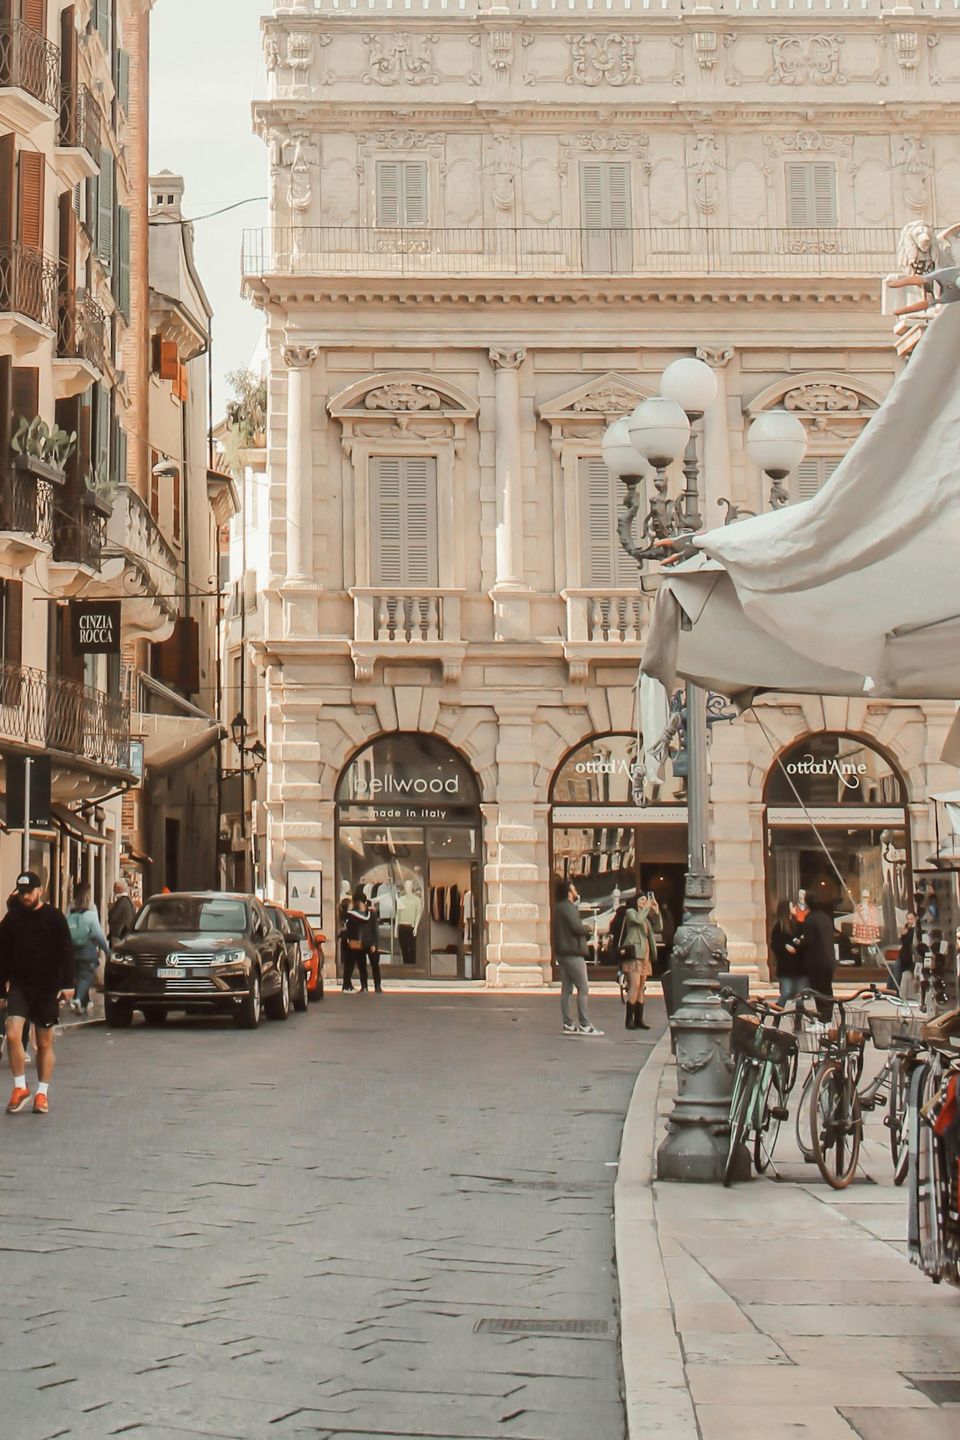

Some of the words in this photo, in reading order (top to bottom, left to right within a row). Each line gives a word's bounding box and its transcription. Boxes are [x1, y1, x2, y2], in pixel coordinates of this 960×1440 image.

[79, 615, 113, 629] CINZIA
[80, 629, 113, 643] ROCCA
[354, 774, 459, 793] bellwood
[370, 808, 400, 818] made
[406, 808, 416, 818] in
